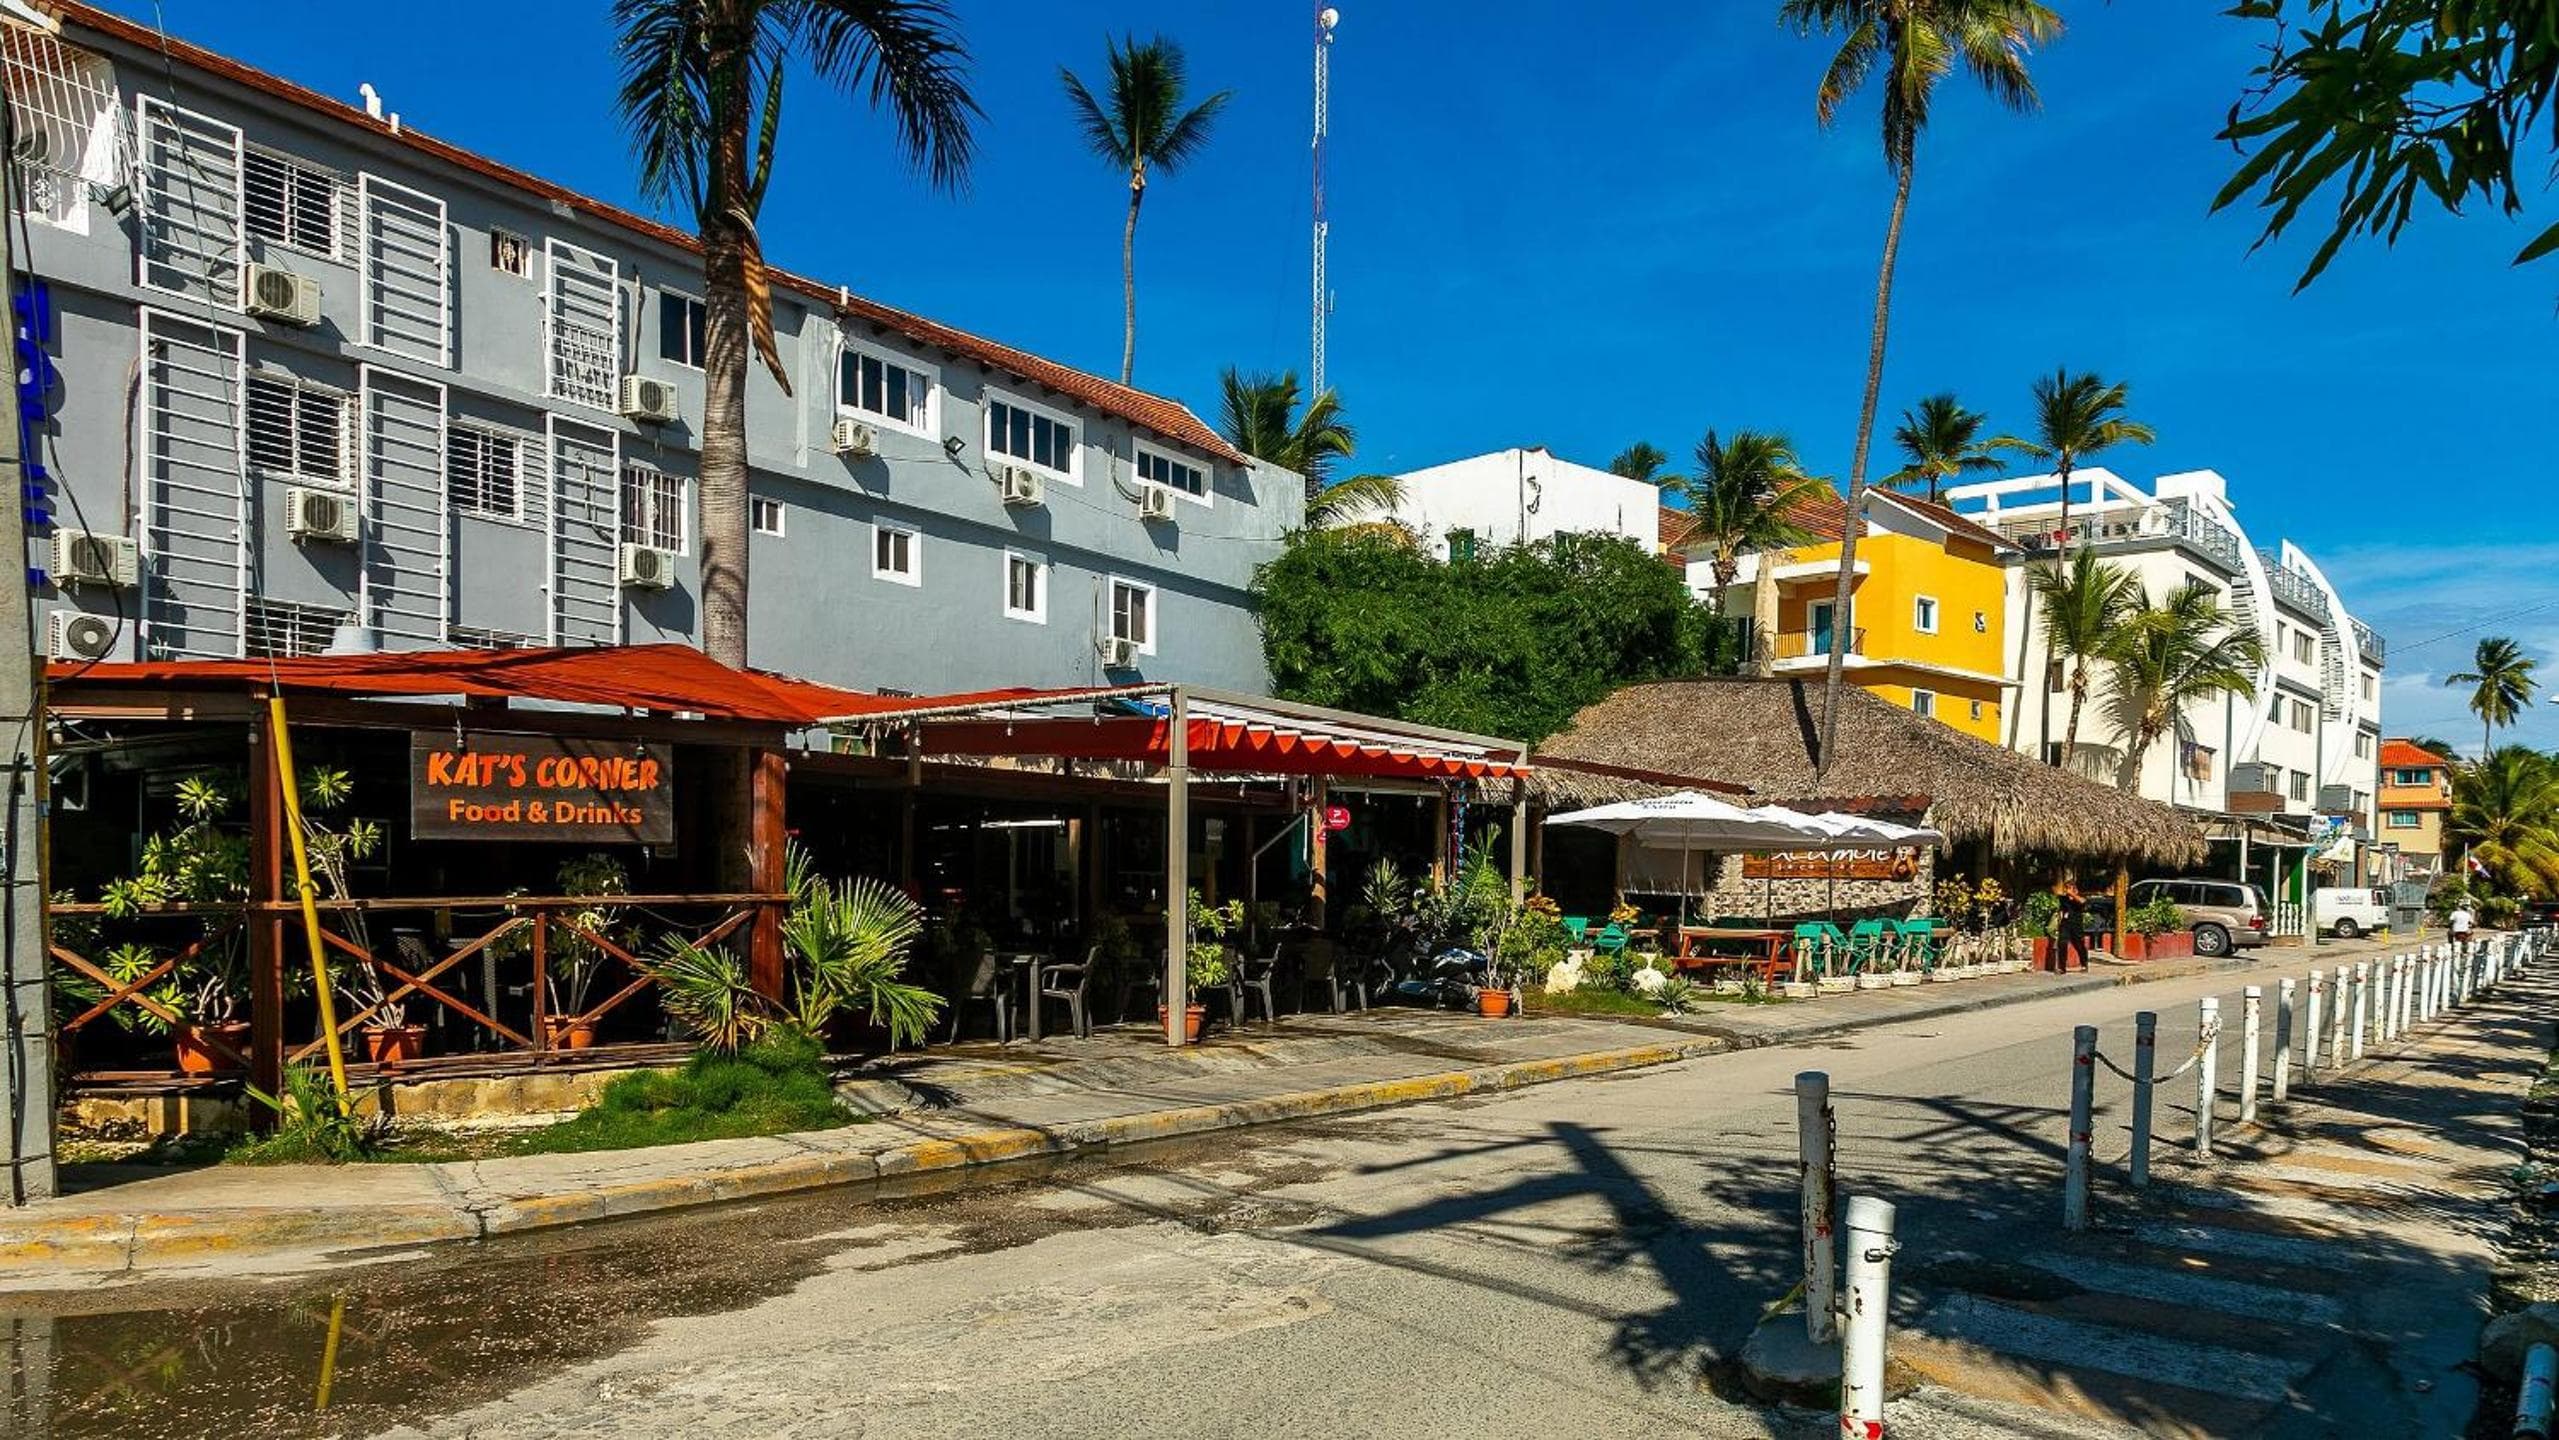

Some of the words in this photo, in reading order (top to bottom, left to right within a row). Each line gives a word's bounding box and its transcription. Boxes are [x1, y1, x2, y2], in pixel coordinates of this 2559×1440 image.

[427, 751, 527, 788] KAT'S
[536, 756, 659, 791] CORNER
[449, 799, 521, 822] Food
[527, 800, 548, 823] &
[555, 801, 642, 824] Drinks
